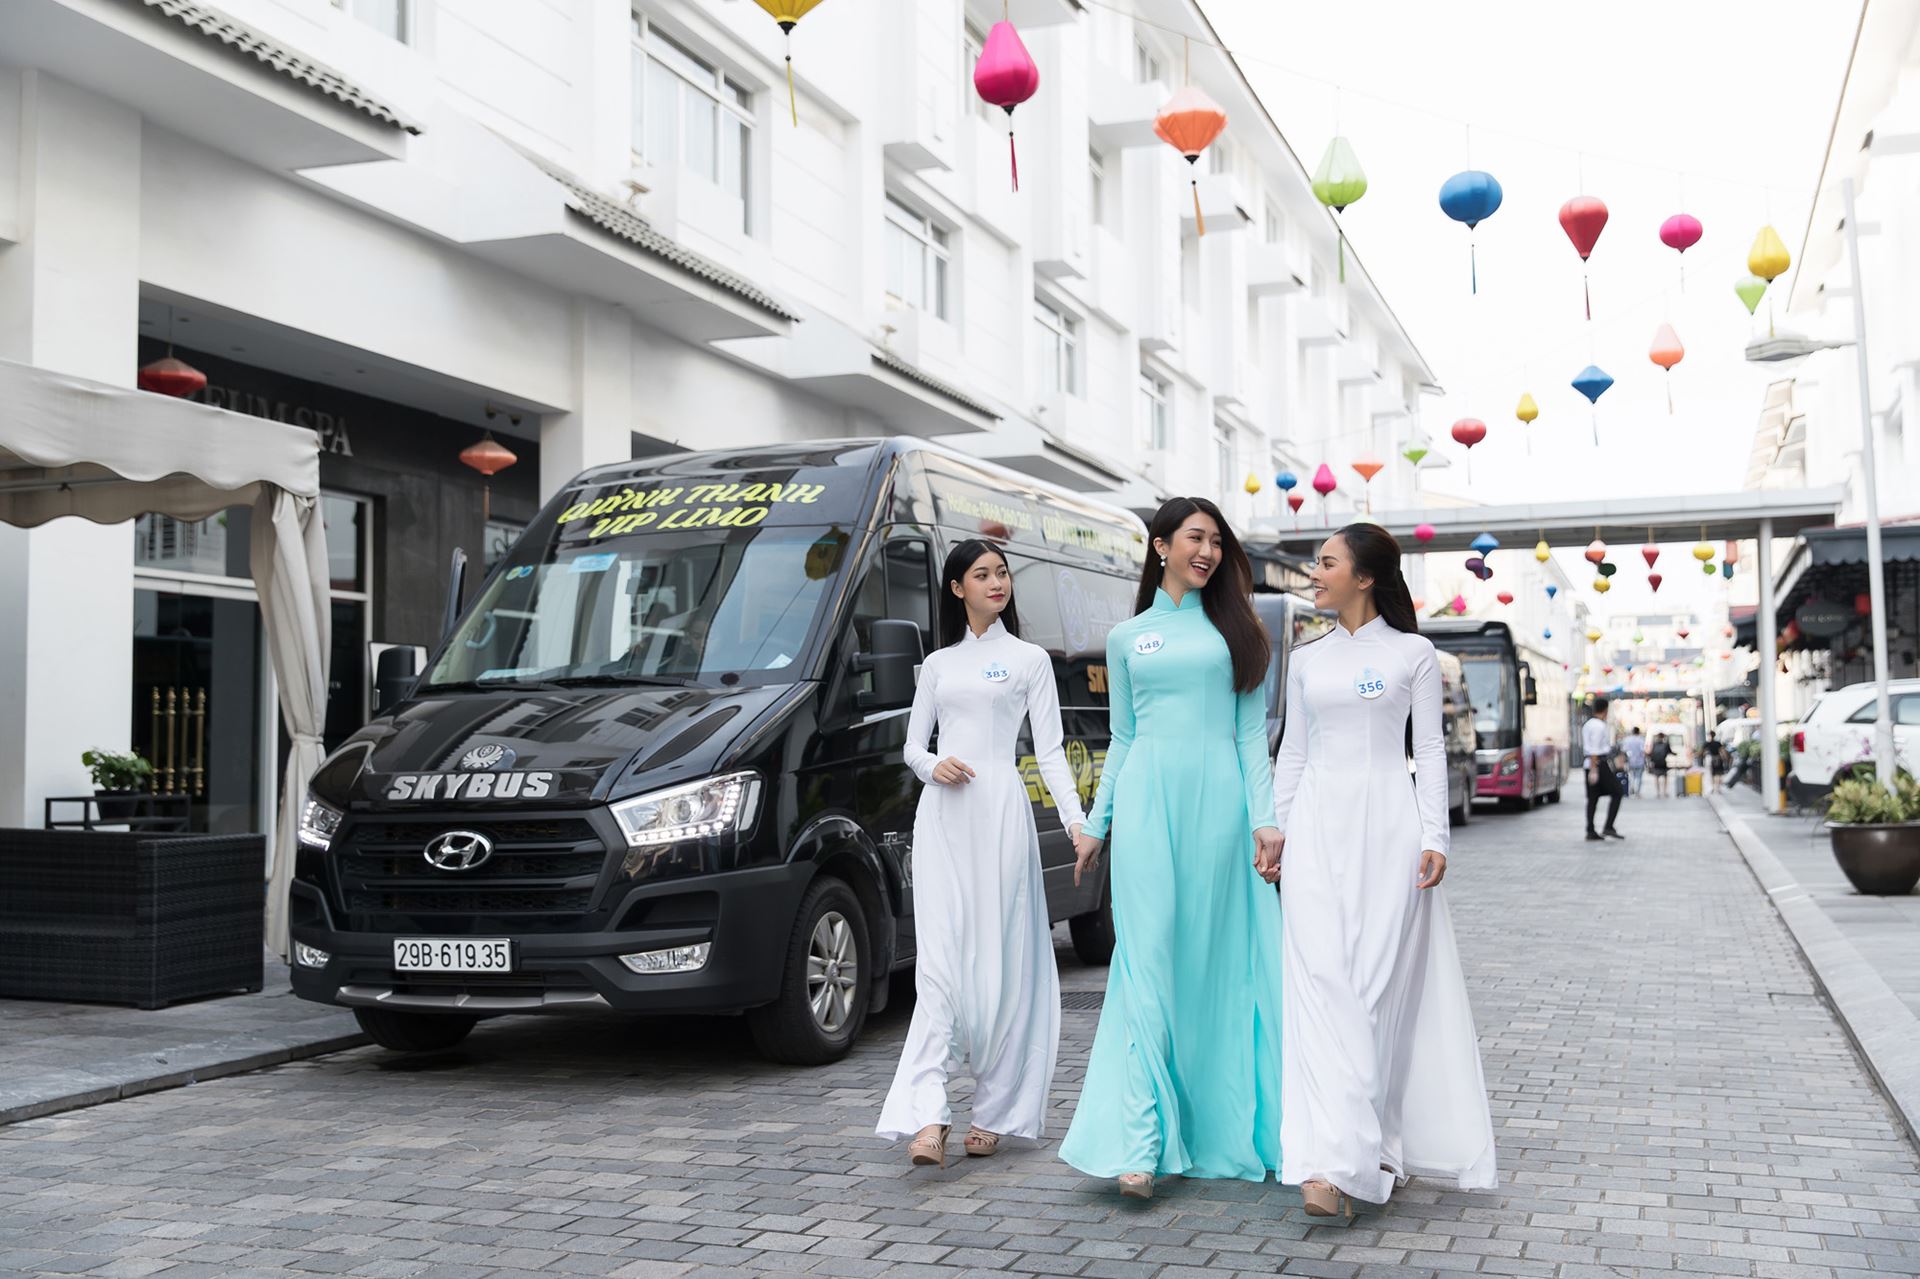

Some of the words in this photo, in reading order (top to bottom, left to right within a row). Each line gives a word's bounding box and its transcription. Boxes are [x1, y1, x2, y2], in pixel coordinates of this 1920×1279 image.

[684, 483, 825, 503] THANH
[588, 512, 657, 538] VIP
[656, 506, 769, 529] LIMO
[1138, 640, 1160, 652] 148
[985, 669, 1008, 679] 383
[1358, 679, 1384, 694] 356
[387, 771, 554, 800] SKYBUS
